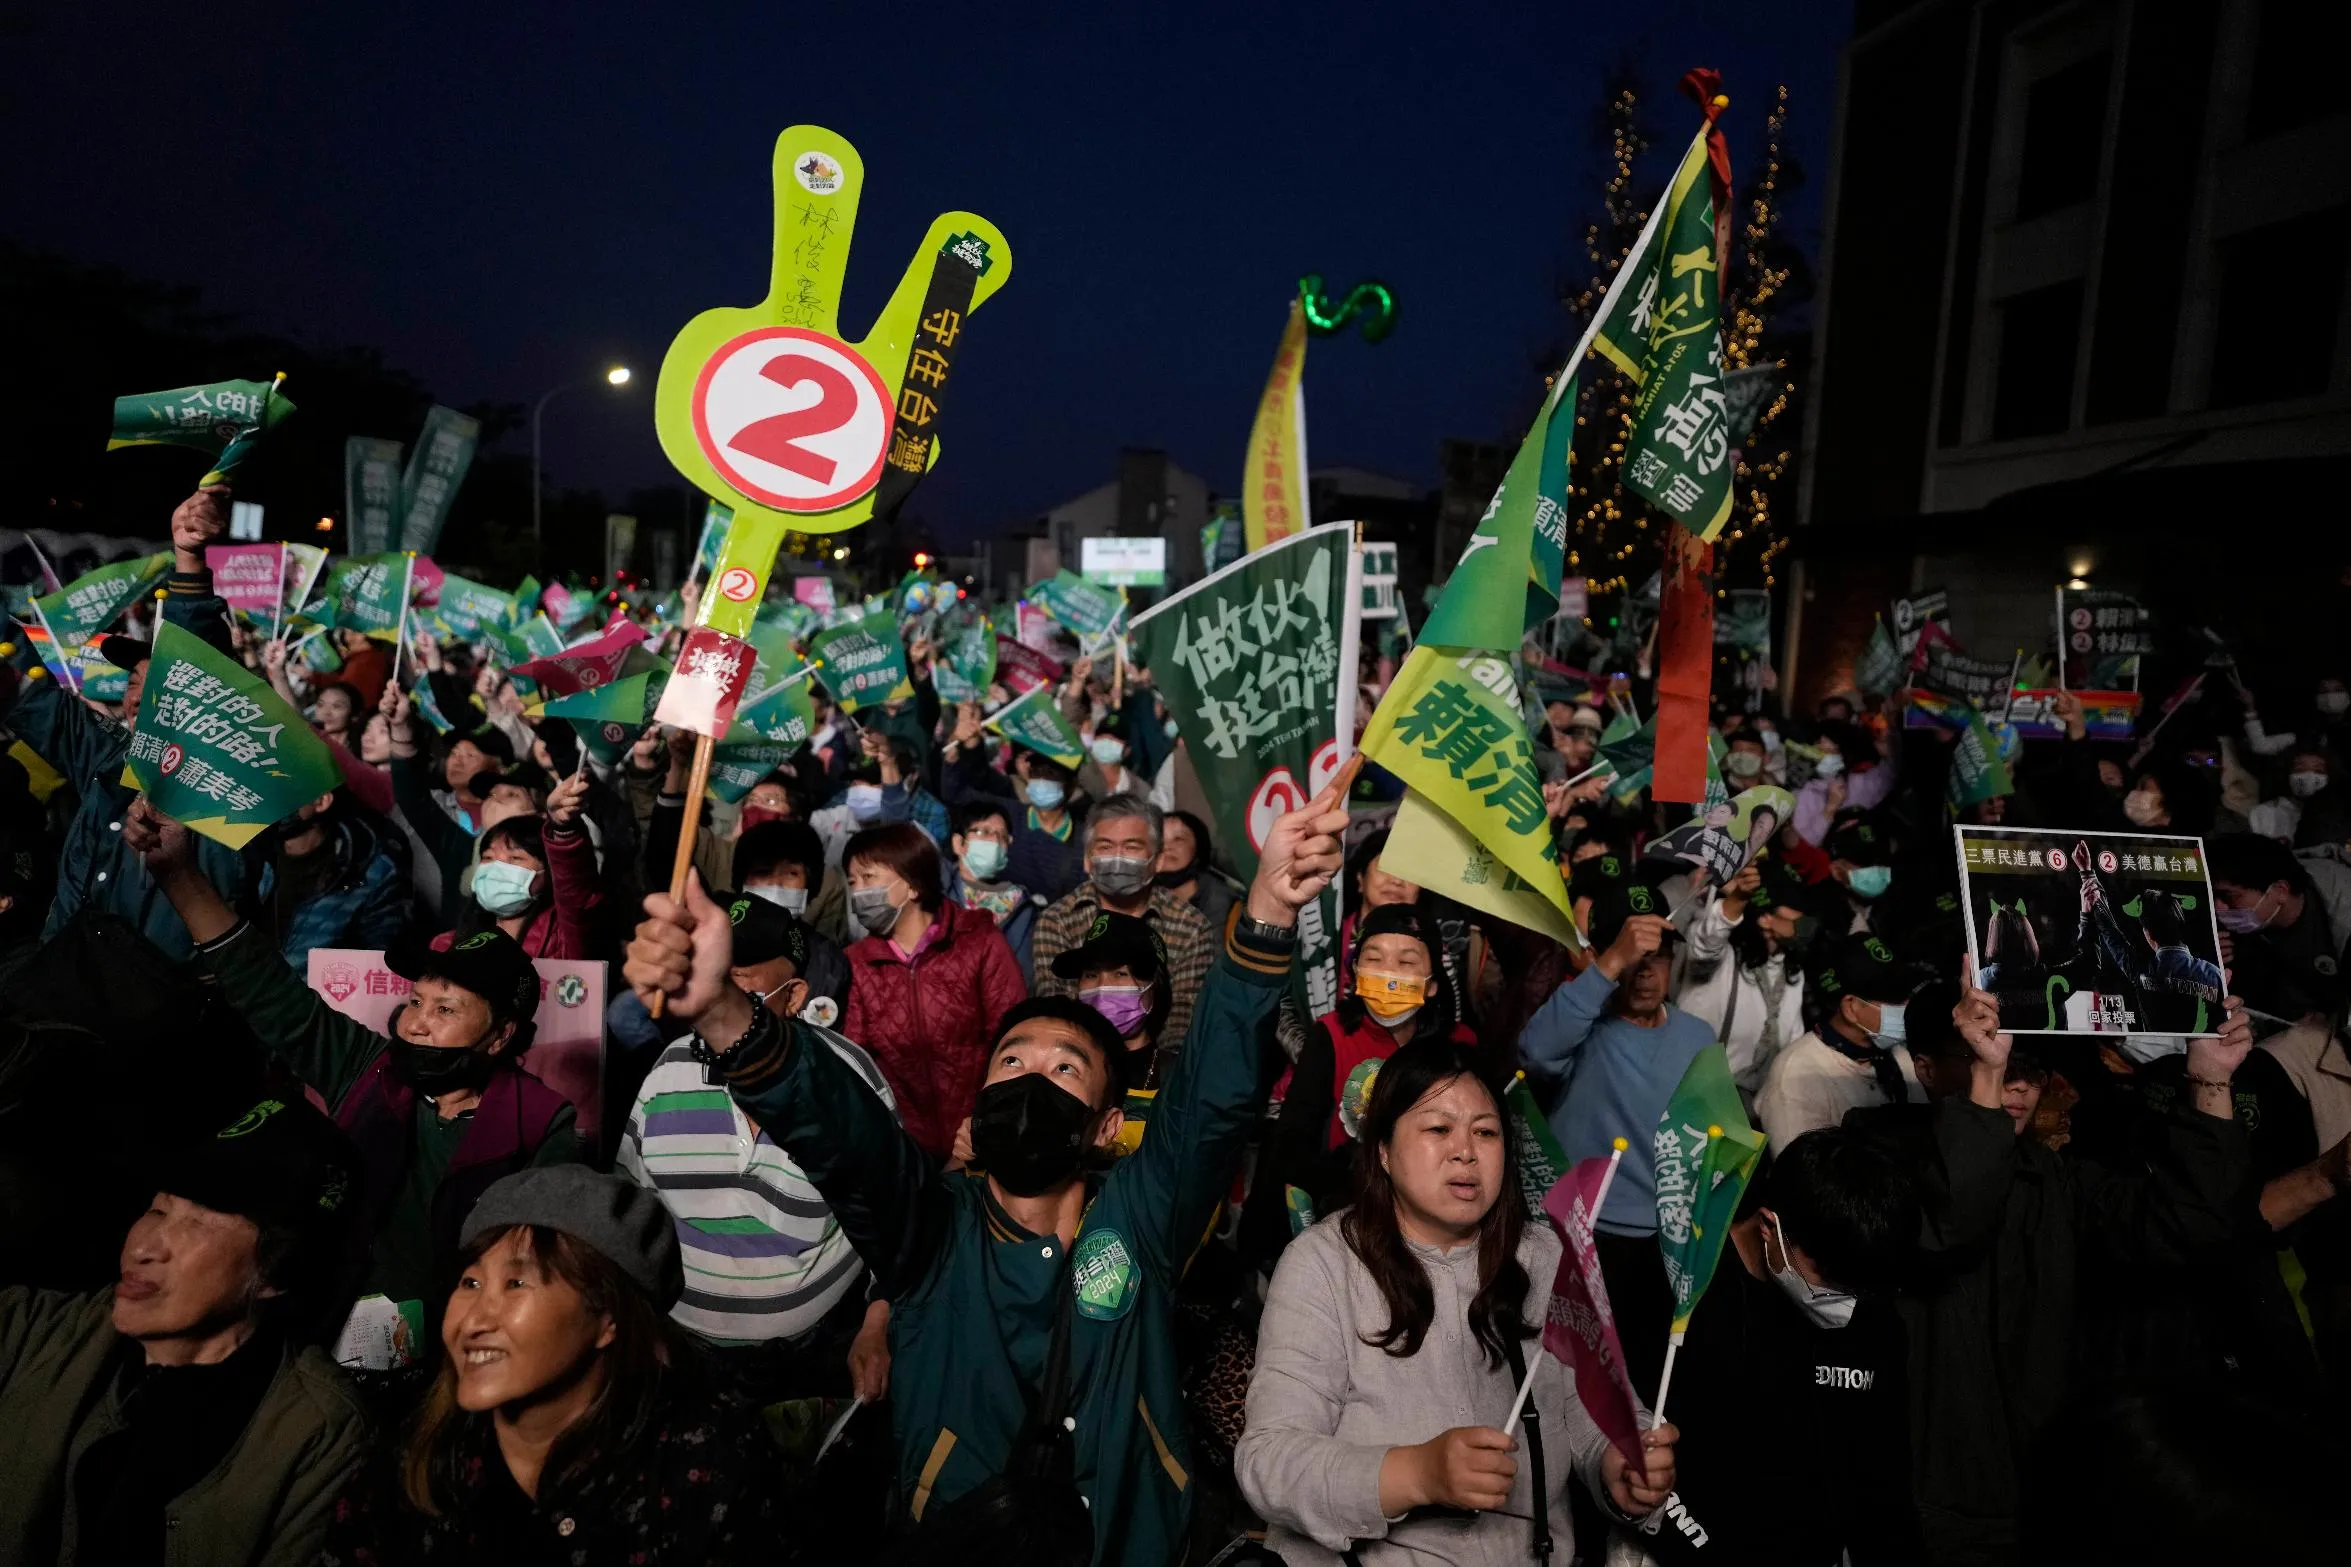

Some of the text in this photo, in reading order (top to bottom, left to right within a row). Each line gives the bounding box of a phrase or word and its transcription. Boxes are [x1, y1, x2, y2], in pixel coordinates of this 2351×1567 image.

[887, 308, 961, 473] 守住台灣
[720, 348, 866, 490] 2
[725, 570, 752, 599] 2
[154, 693, 279, 768] 走對的路!
[163, 659, 286, 749] 選對的人
[174, 756, 265, 811] 蕭美琴
[1393, 680, 1556, 850] 賴清
[1965, 848, 2044, 868] 三票民進黨
[2121, 853, 2199, 874] 美德贏台灣
[2088, 1010, 2137, 1025] 回家投票
[1089, 1270, 1122, 1299] 2024
